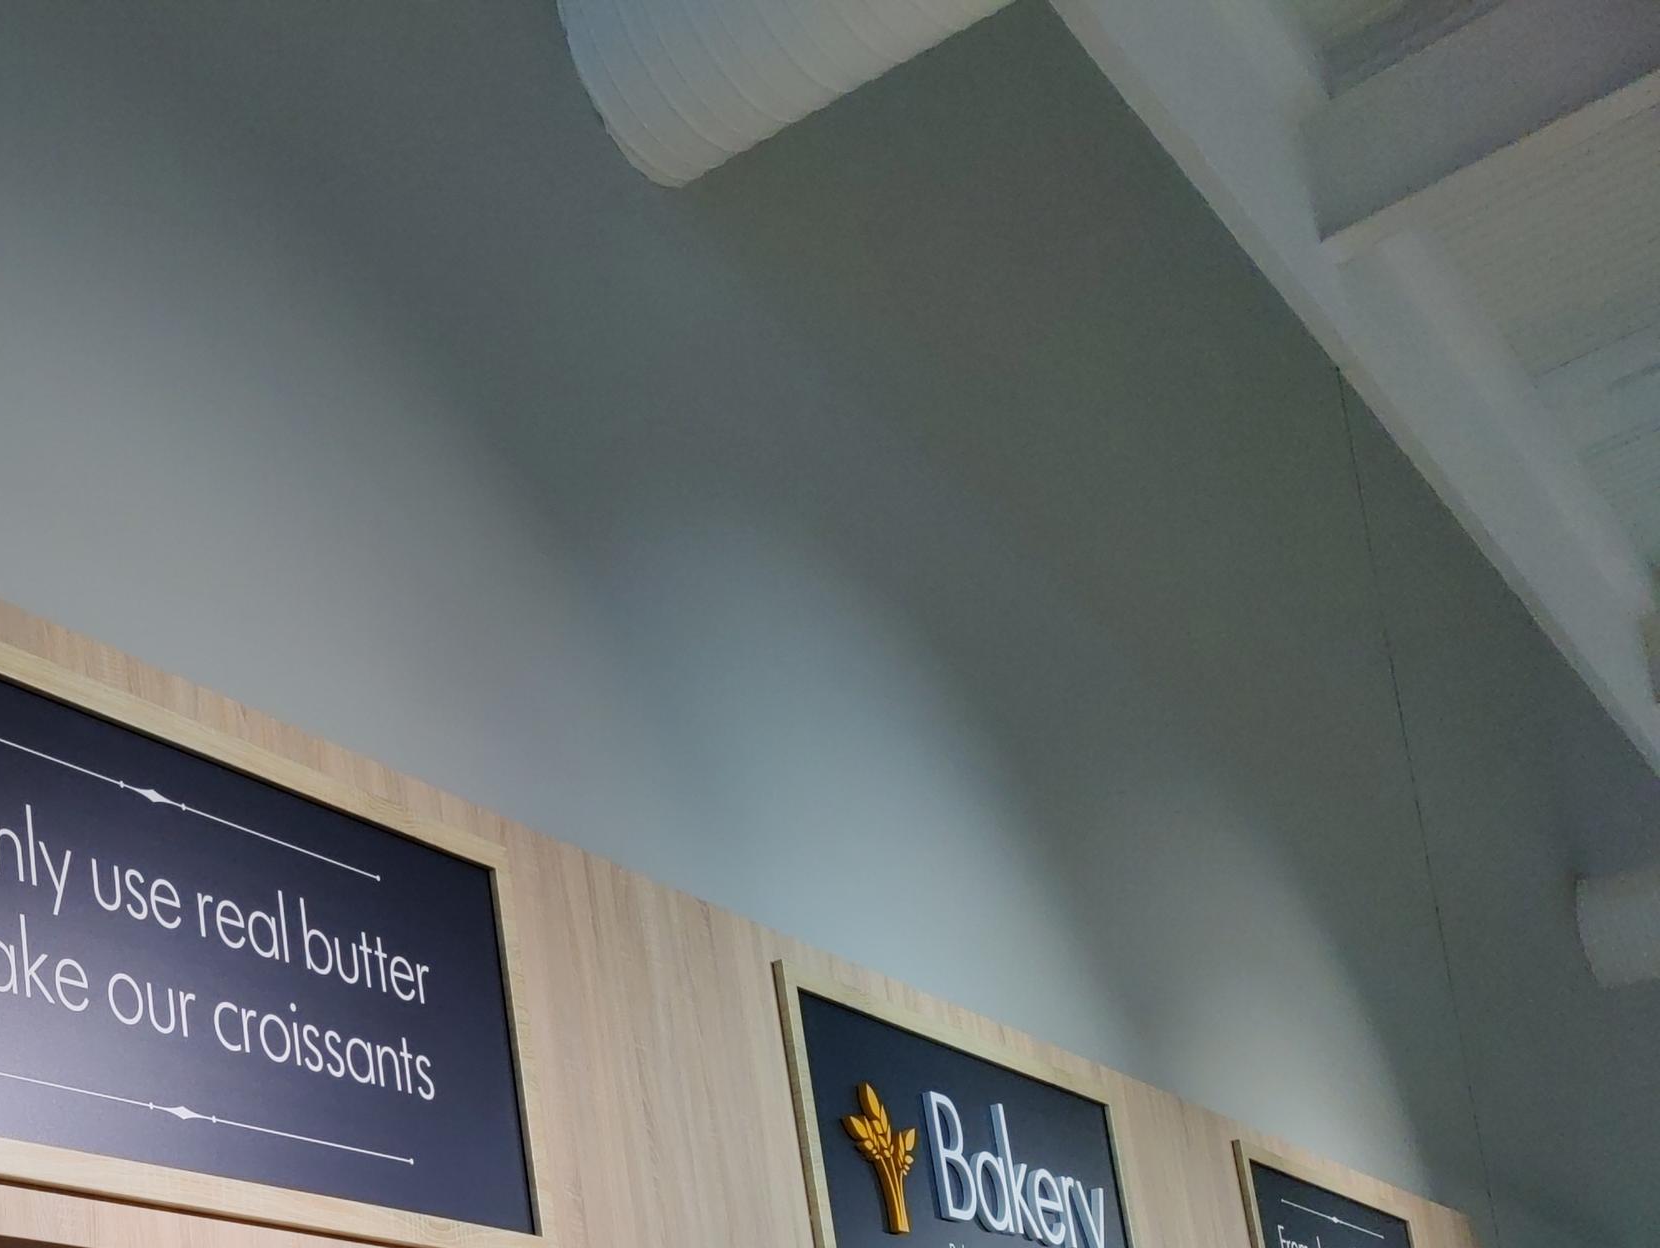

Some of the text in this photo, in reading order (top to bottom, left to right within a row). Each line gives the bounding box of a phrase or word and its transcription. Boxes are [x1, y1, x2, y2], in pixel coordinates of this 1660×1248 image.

[91, 858, 181, 929] use
[197, 890, 288, 963] real
[301, 898, 429, 1005] butter
[109, 972, 196, 1040] our
[214, 1001, 436, 1101] croissants
